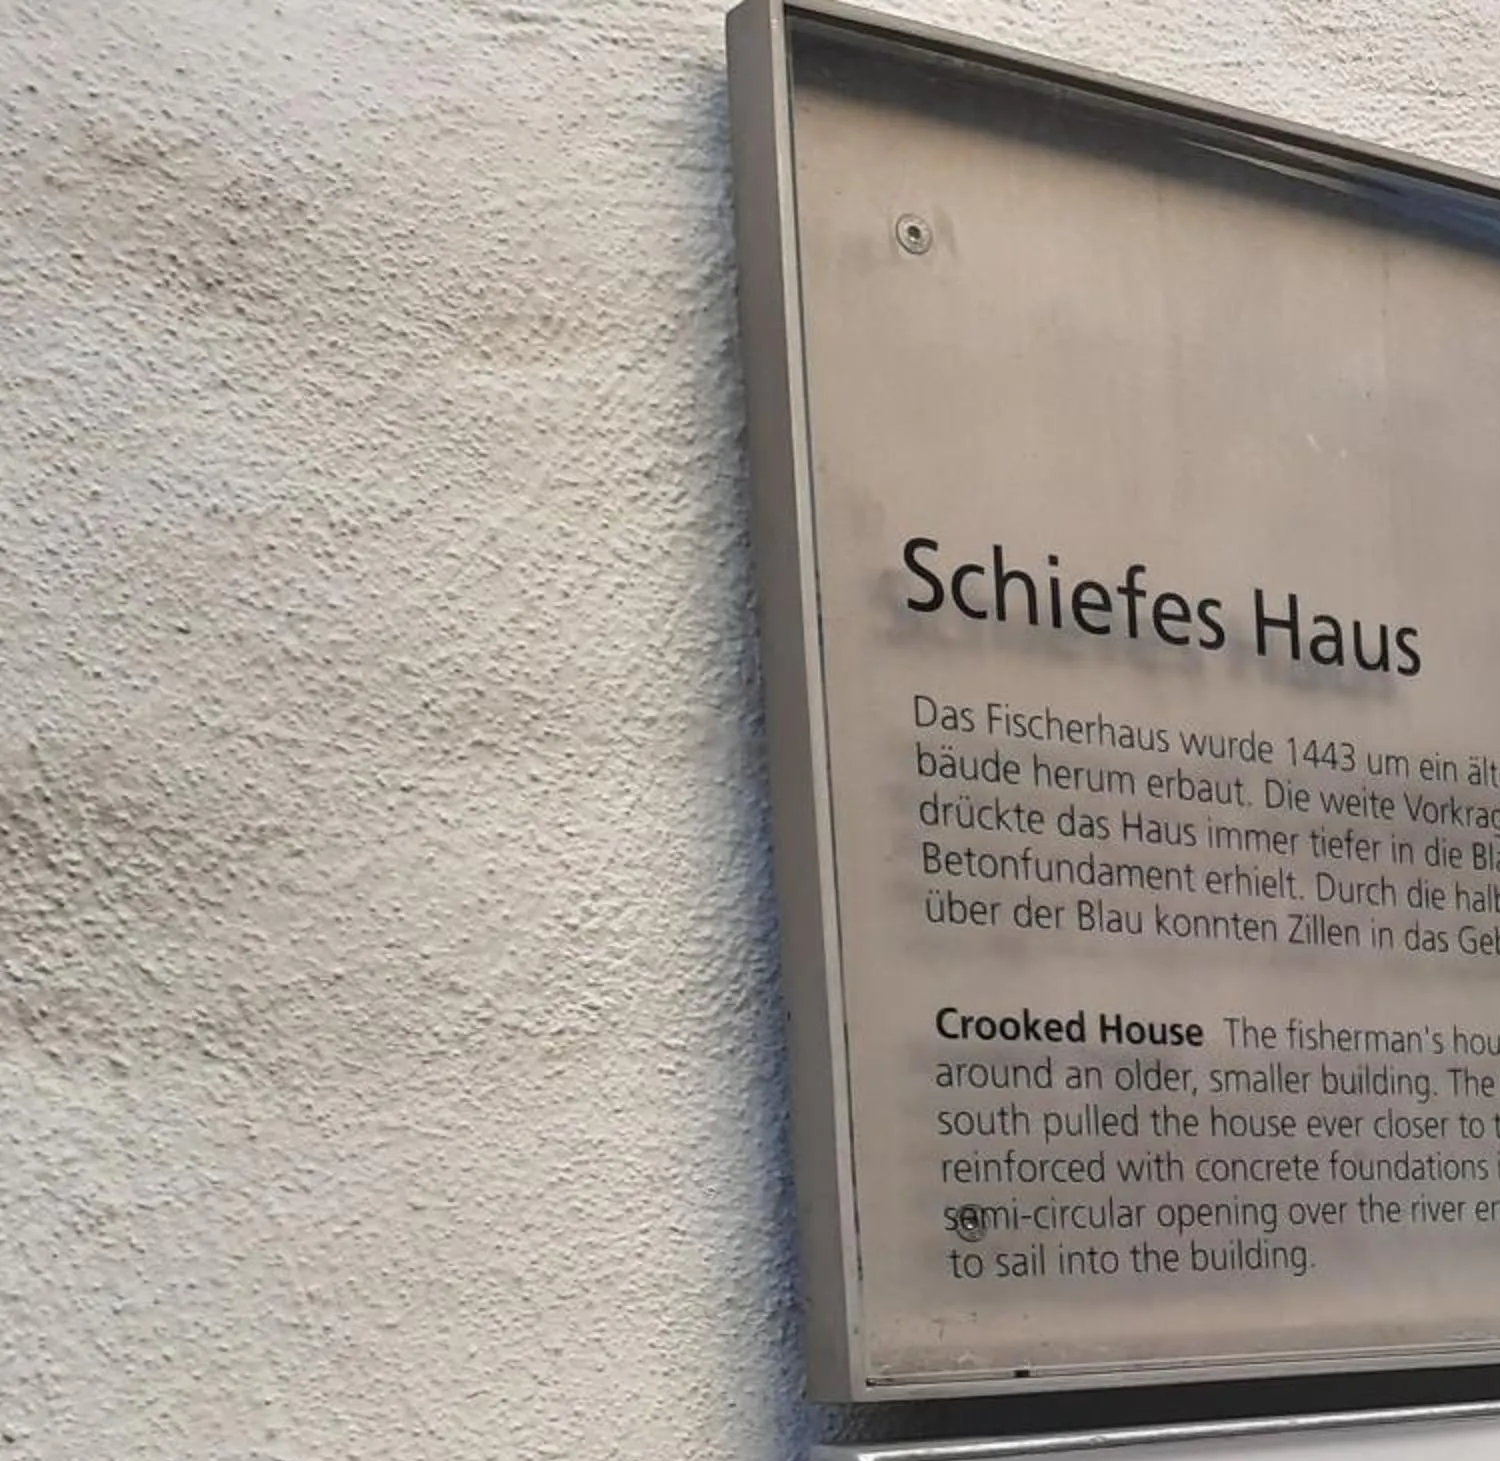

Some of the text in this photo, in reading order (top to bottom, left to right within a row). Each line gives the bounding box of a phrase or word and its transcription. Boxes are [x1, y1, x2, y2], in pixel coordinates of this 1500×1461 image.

[904, 538, 1421, 677] Schiefes Haus
[913, 694, 975, 733] Das
[987, 702, 1170, 753] Fischerhaus
[1179, 730, 1272, 764] wurde
[1287, 737, 1356, 773] 1443
[1367, 753, 1409, 778] um
[1419, 752, 1458, 783] ein
[916, 742, 1020, 785] bäude
[1033, 753, 1135, 795] herum
[1147, 768, 1252, 807] erbaut.
[1265, 778, 1310, 812] Die
[1319, 786, 1395, 820] weite
[919, 793, 1045, 835] drückte
[1057, 804, 1110, 840] das
[1122, 810, 1196, 847] Haus
[1207, 816, 1299, 855] immer
[1309, 826, 1381, 861] tiefer
[1392, 834, 1413, 864] in
[1425, 837, 1462, 869] die
[922, 841, 1195, 893] Betonfundament
[1205, 863, 1304, 900] erhielt.
[1316, 872, 1396, 906] Durch
[1407, 878, 1445, 910] die
[925, 890, 1001, 926] über
[1013, 895, 1064, 929] der
[1077, 899, 1143, 934] Blau
[1155, 903, 1277, 941] konnten
[1288, 913, 1360, 947] Zillen
[1371, 919, 1393, 948] in
[1404, 920, 1448, 953] das
[936, 1007, 1086, 1043] Crooked
[1099, 1013, 1204, 1047] House
[1223, 1016, 1276, 1049] The
[1286, 1018, 1443, 1054] fisherman's
[936, 1056, 1052, 1088] around
[1065, 1066, 1102, 1090] an
[1115, 1058, 1197, 1096] older,
[1210, 1062, 1311, 1094] smaller
[1321, 1063, 1437, 1103] building.
[1446, 1067, 1494, 1097] The
[938, 1103, 1030, 1136] south
[1043, 1104, 1139, 1144] pulled
[1149, 1105, 1199, 1136] the
[1210, 1105, 1296, 1137] house
[1307, 1115, 1363, 1138] ever
[1373, 1107, 1449, 1139] closer
[1458, 1113, 1484, 1138] to
[942, 1149, 1105, 1183] reinforced
[1116, 1150, 1184, 1182] with
[1195, 1153, 1319, 1182] concrete
[1328, 1149, 1489, 1181] foundations
[944, 1195, 1146, 1240] semi-circular
[1157, 1195, 1277, 1235] opening
[1288, 1201, 1347, 1225] over
[1357, 1192, 1401, 1224] the
[1411, 1193, 1466, 1222] river
[947, 1238, 1315, 1279] to sail into the building.
